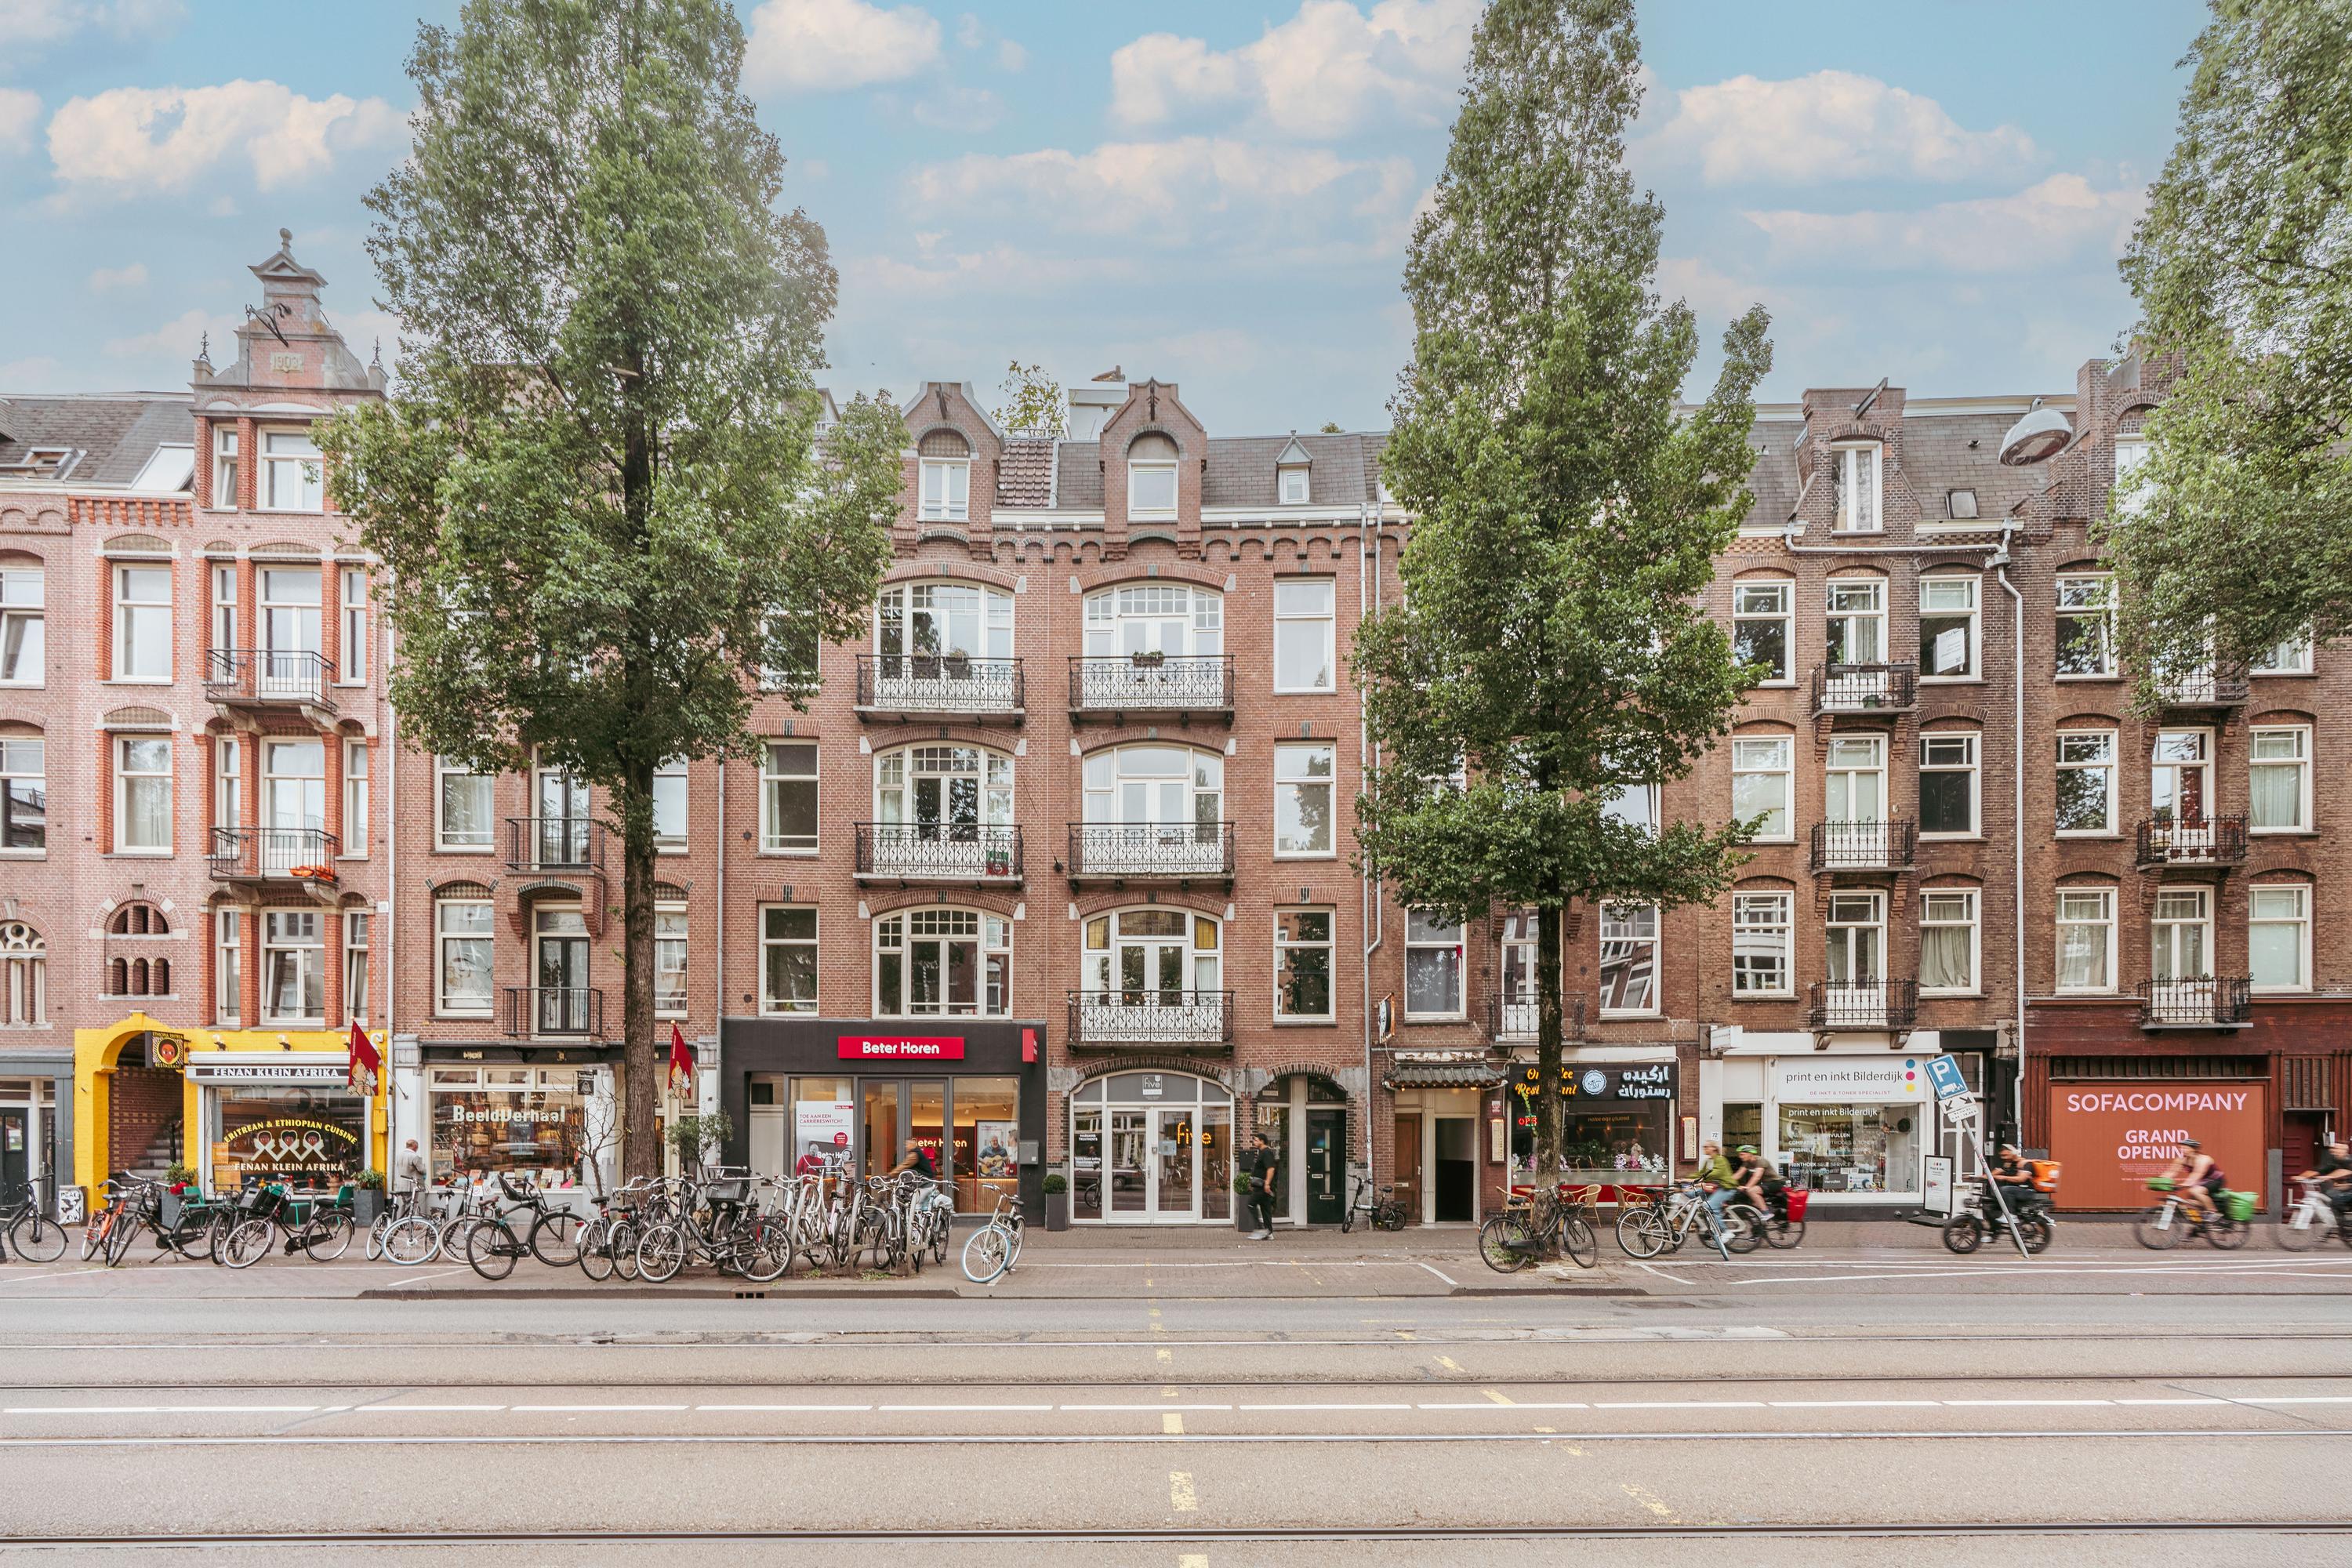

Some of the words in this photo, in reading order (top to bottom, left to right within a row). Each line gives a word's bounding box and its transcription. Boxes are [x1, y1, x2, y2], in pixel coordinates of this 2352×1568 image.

[862, 1041, 898, 1054] Beter
[901, 1041, 940, 1054] Horen
[213, 1068, 252, 1076] FENAN
[257, 1068, 291, 1076] KLEIN
[295, 1068, 339, 1076] AFRIKA
[1786, 1072, 1811, 1083] print
[1831, 1071, 1850, 1081] inkt
[1853, 1071, 1903, 1083] Bilderdijk
[1931, 1061, 1950, 1082] P
[2067, 1092, 2248, 1112] SOFACOMPANY
[1788, 1108, 1808, 1117] print
[1822, 1108, 1838, 1116] inkt
[1840, 1107, 1878, 1118] Bilderdijk
[223, 1122, 265, 1144] ERITREAN
[275, 1119, 322, 1130] ETHIOPIAN
[325, 1124, 358, 1145] CUISINE
[2125, 1129, 2189, 1143] GRAND
[2118, 1145, 2185, 1160] OPENIN
[306, 1163, 344, 1171] AFRIKA
